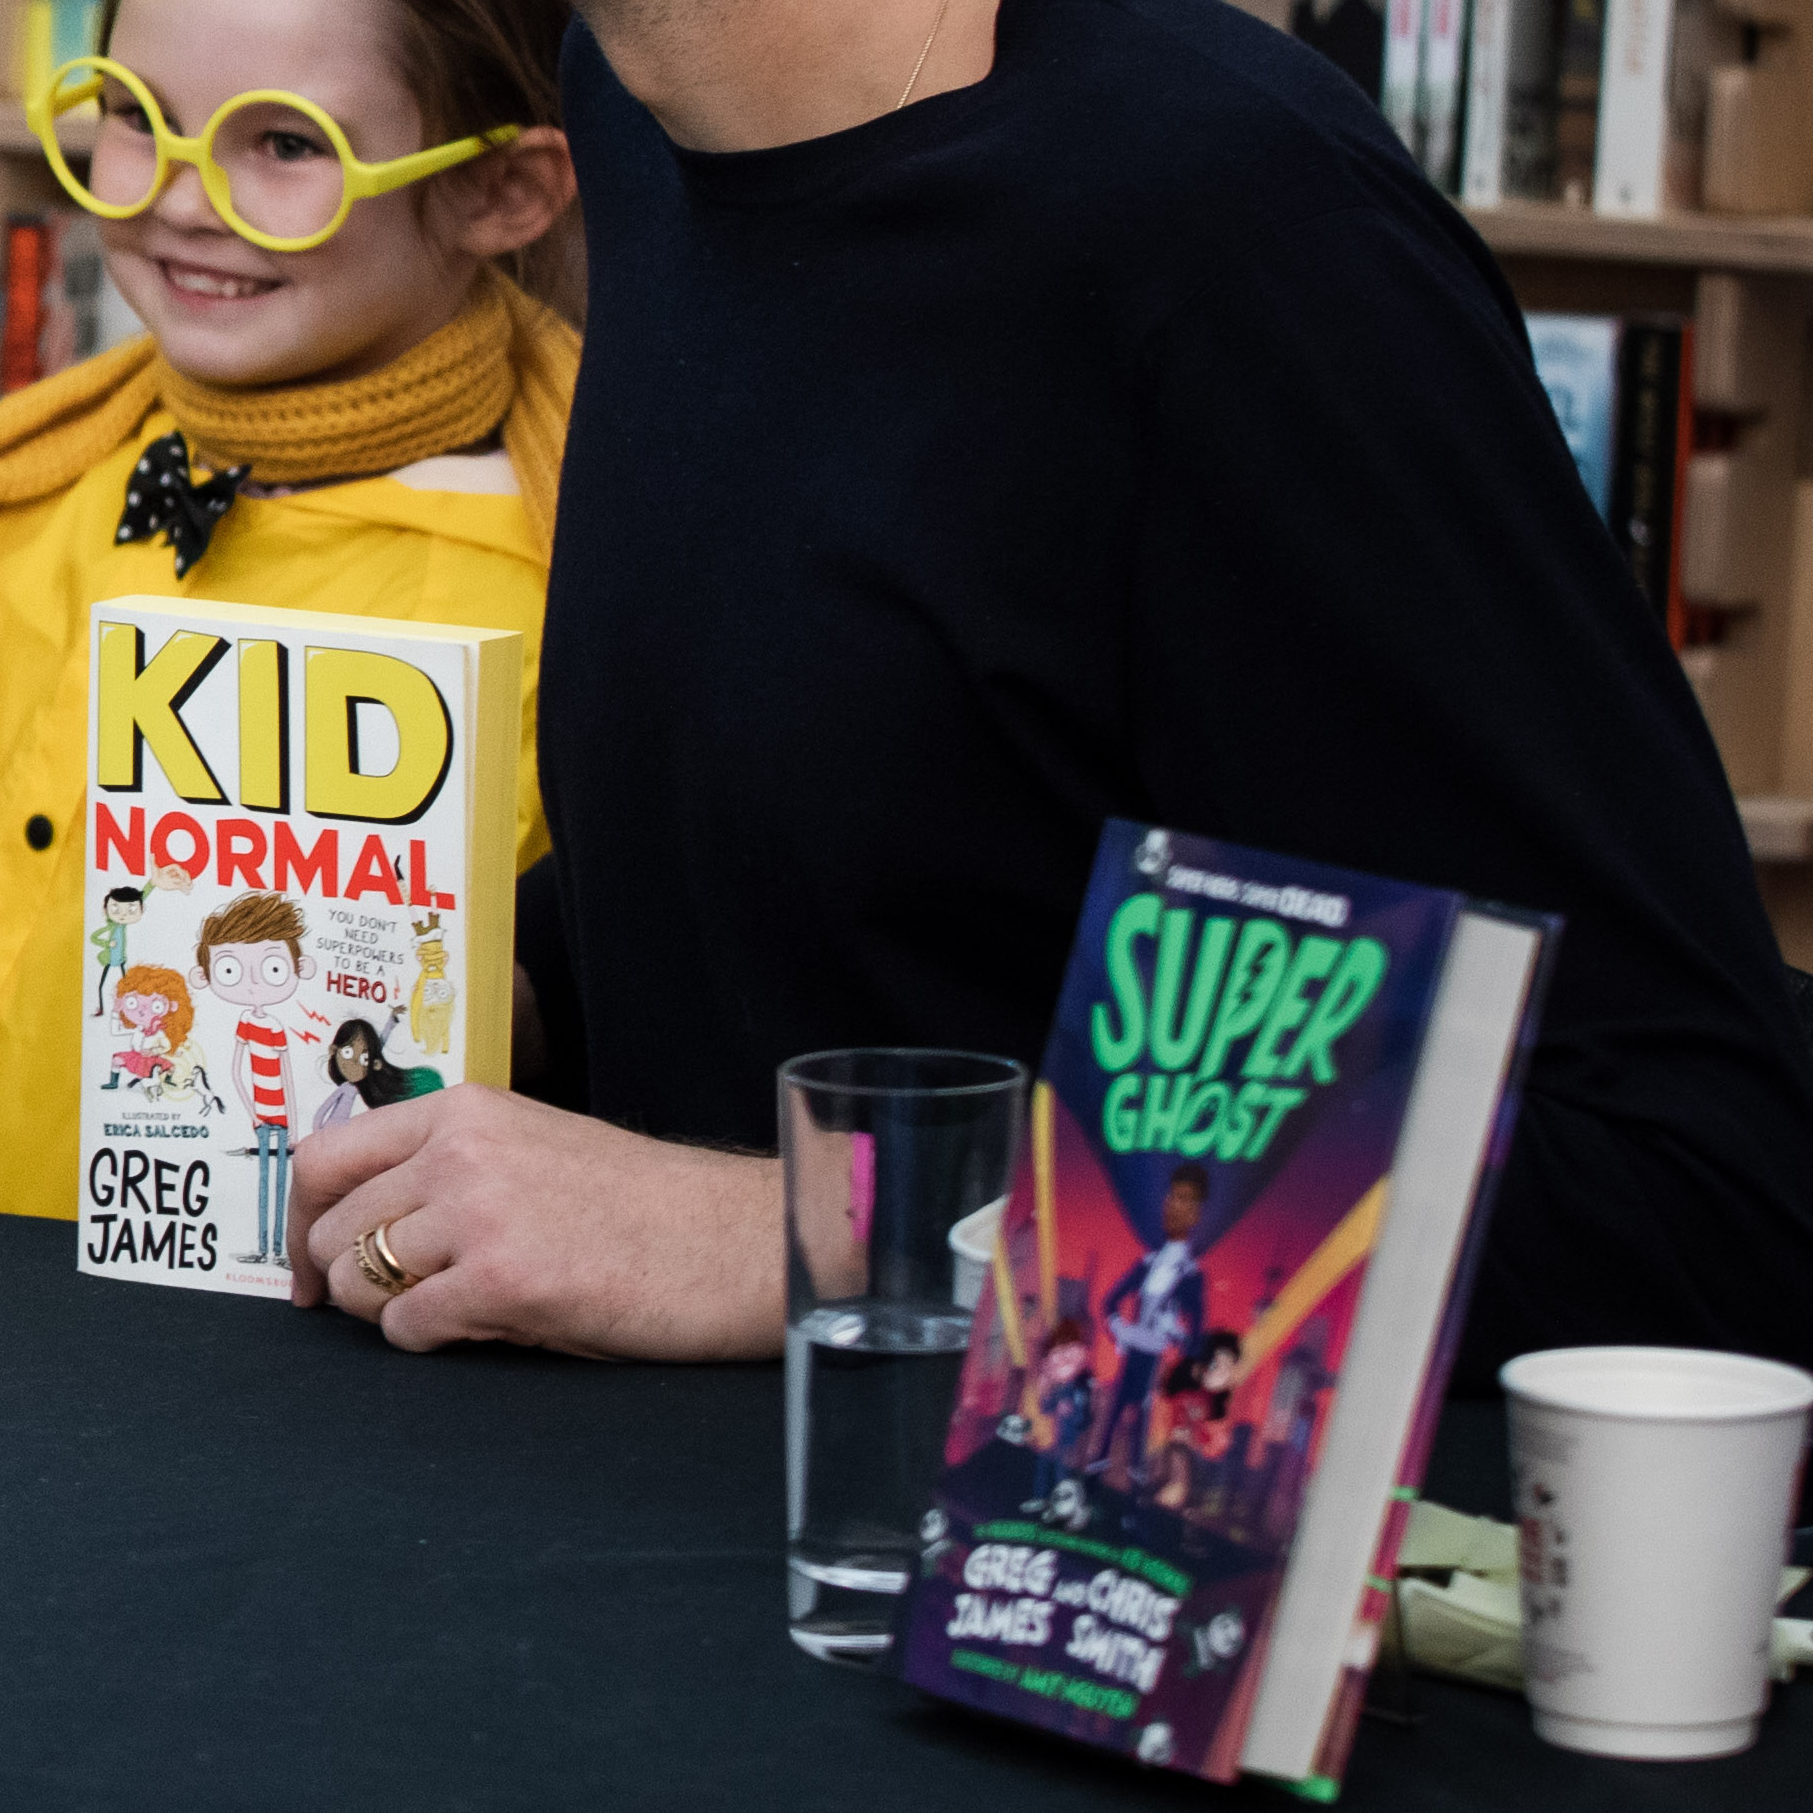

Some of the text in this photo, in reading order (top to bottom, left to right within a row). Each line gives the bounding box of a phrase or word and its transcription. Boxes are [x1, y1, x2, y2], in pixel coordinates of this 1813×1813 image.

[97, 619, 455, 826] KID
[94, 800, 458, 912] NORMAL
[329, 909, 354, 925] YOU
[345, 929, 379, 945] NEED
[316, 937, 405, 965] SUPERPOWERS
[334, 956, 351, 969] TO
[356, 960, 371, 974] BE
[326, 970, 387, 1004] HERO
[1091, 892, 1389, 1084] SUPER
[103, 1122, 210, 1139] ERICA SALCEDO
[1102, 1072, 1309, 1161] GHOST
[88, 1146, 211, 1218] GREG
[87, 1213, 219, 1272] JAMES
